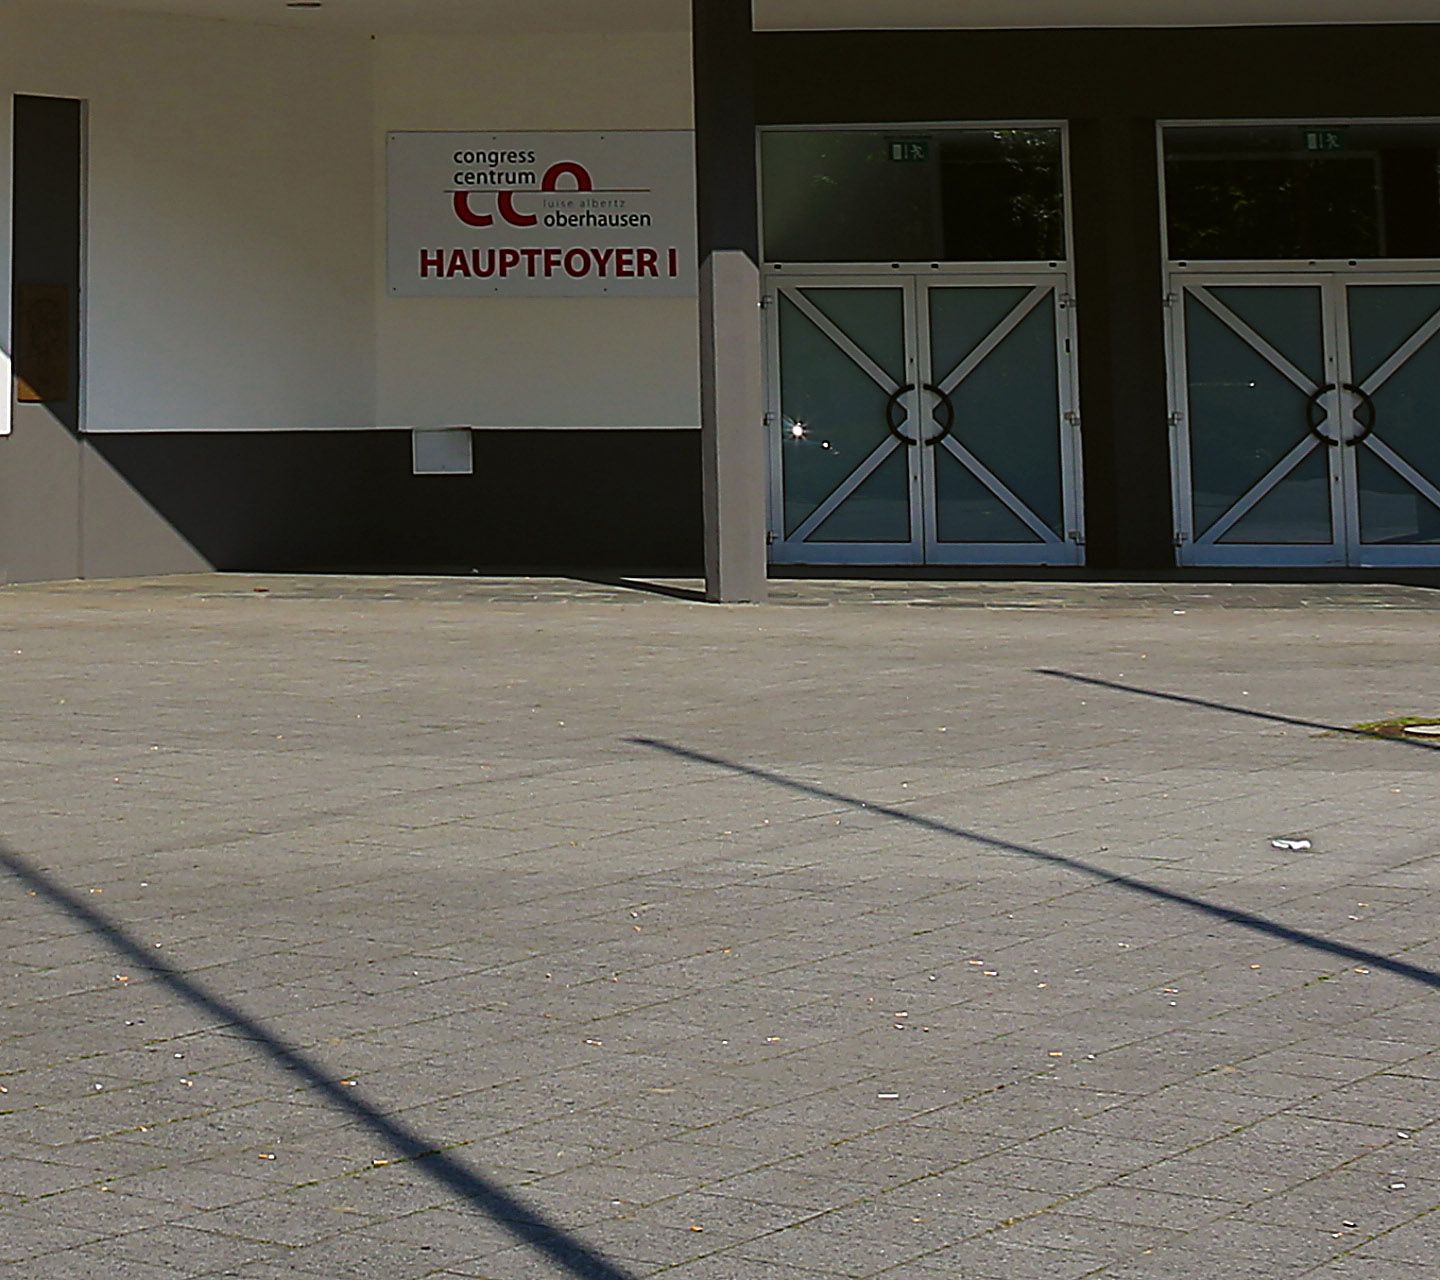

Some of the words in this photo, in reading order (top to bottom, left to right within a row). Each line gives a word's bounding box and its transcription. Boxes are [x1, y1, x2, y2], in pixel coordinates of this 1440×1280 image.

[453, 150, 536, 168] congress
[453, 169, 536, 185] centrum
[543, 198, 574, 209] luise
[579, 198, 626, 209] albertz
[543, 210, 651, 227] oberhausen
[420, 248, 658, 278] HAUPTFOYER
